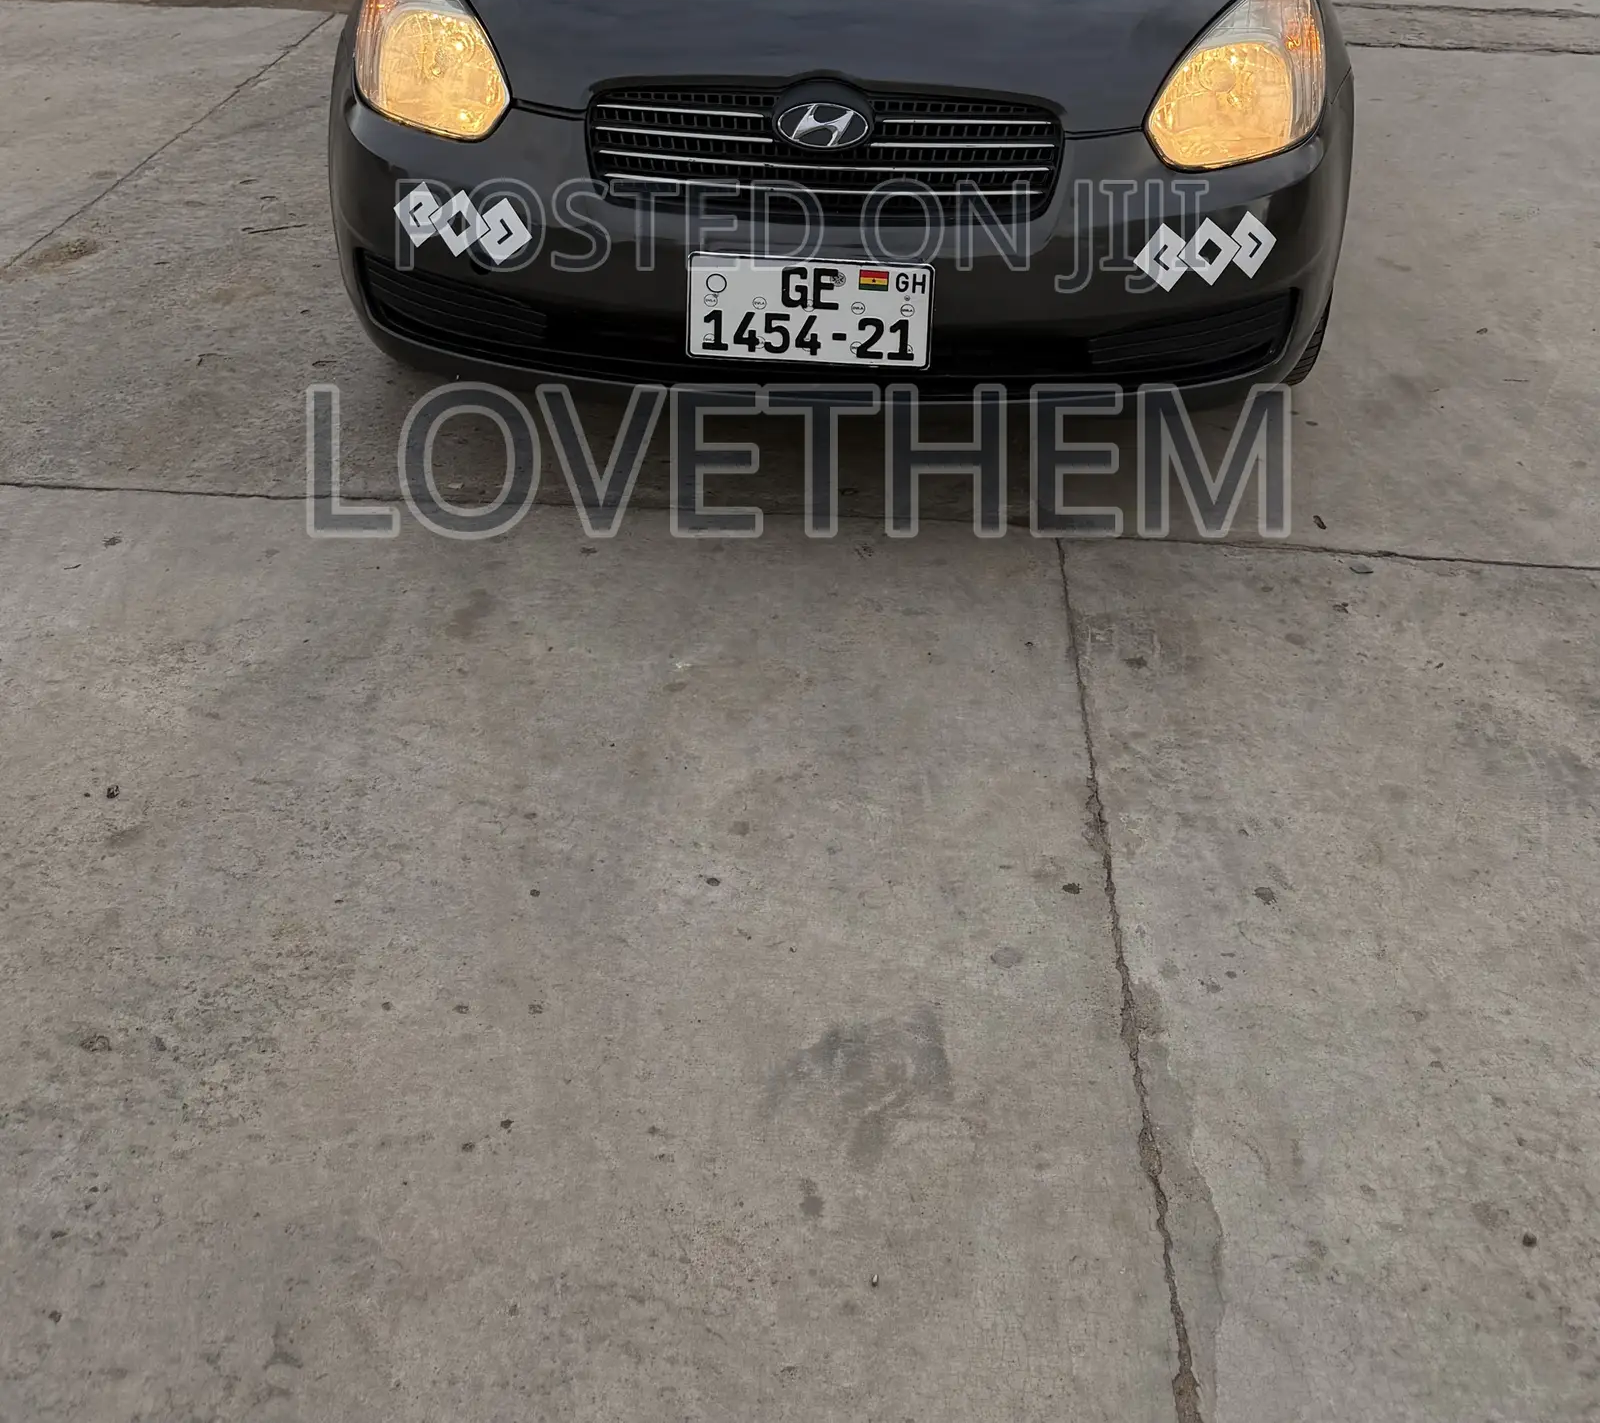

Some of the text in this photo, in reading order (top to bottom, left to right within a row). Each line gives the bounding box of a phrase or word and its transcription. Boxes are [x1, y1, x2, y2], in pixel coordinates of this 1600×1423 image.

[781, 266, 839, 310] GE
[895, 272, 926, 294] GH
[702, 309, 914, 361] 1454-21
